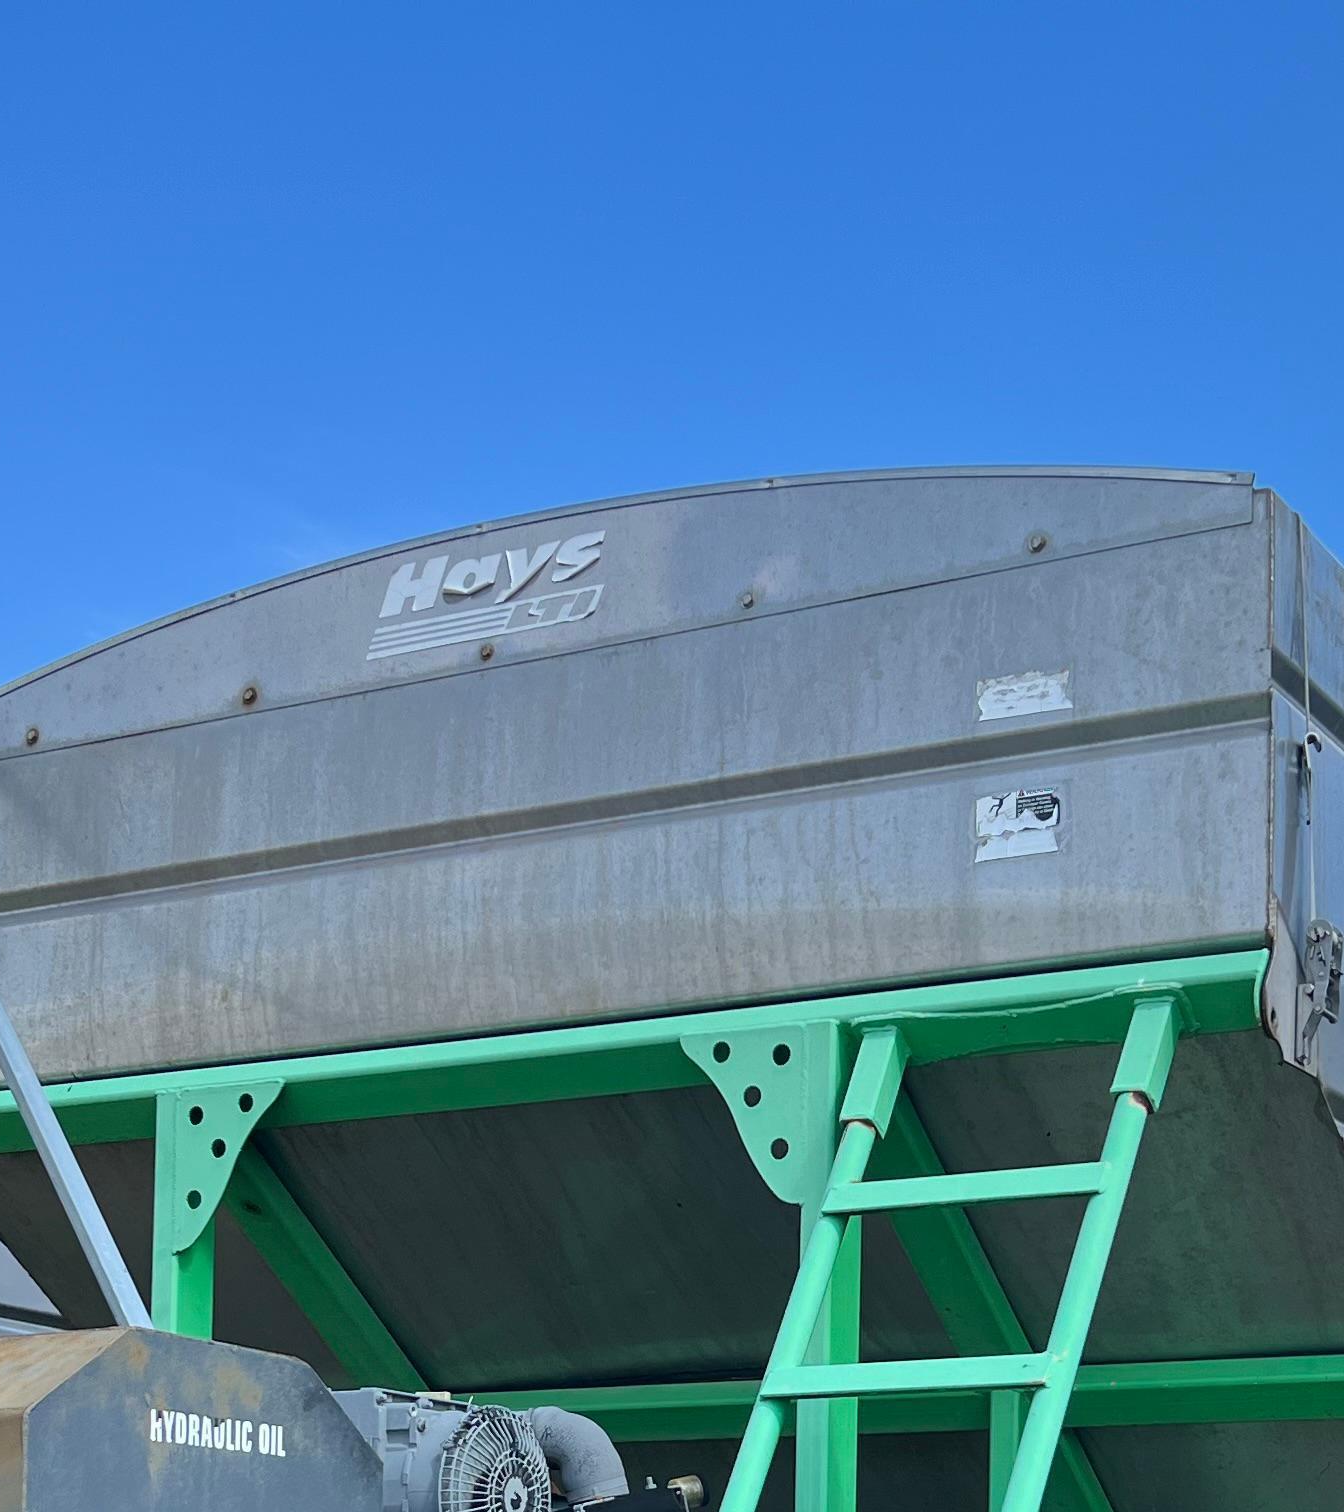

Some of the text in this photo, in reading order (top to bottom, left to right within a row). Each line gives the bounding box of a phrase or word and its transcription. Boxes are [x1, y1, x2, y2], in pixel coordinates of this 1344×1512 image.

[379, 530, 606, 618] Hays
[150, 1408, 286, 1457] HYDRAULIC OIL
